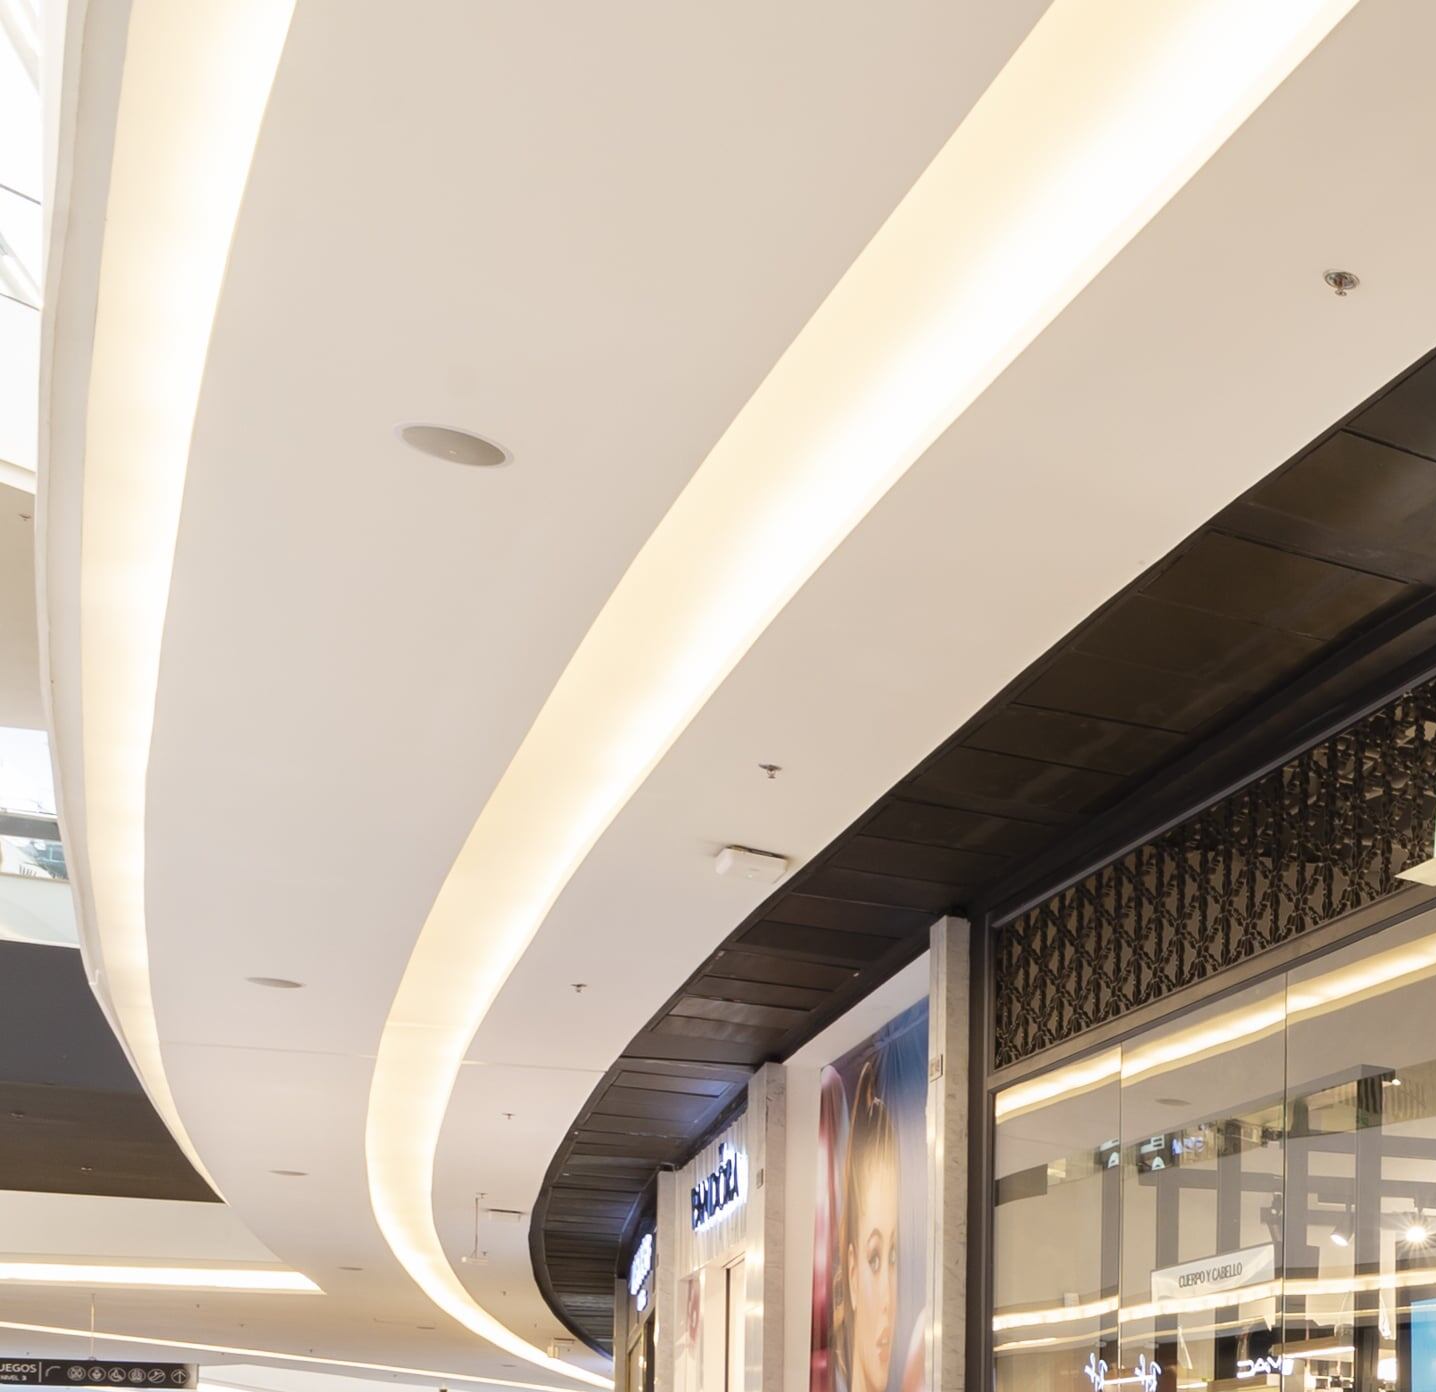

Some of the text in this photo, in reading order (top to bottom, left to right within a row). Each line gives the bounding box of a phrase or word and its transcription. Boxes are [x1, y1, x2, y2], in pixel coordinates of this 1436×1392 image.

[1178, 1262, 1243, 1289] CUERPO Y CABELLO
